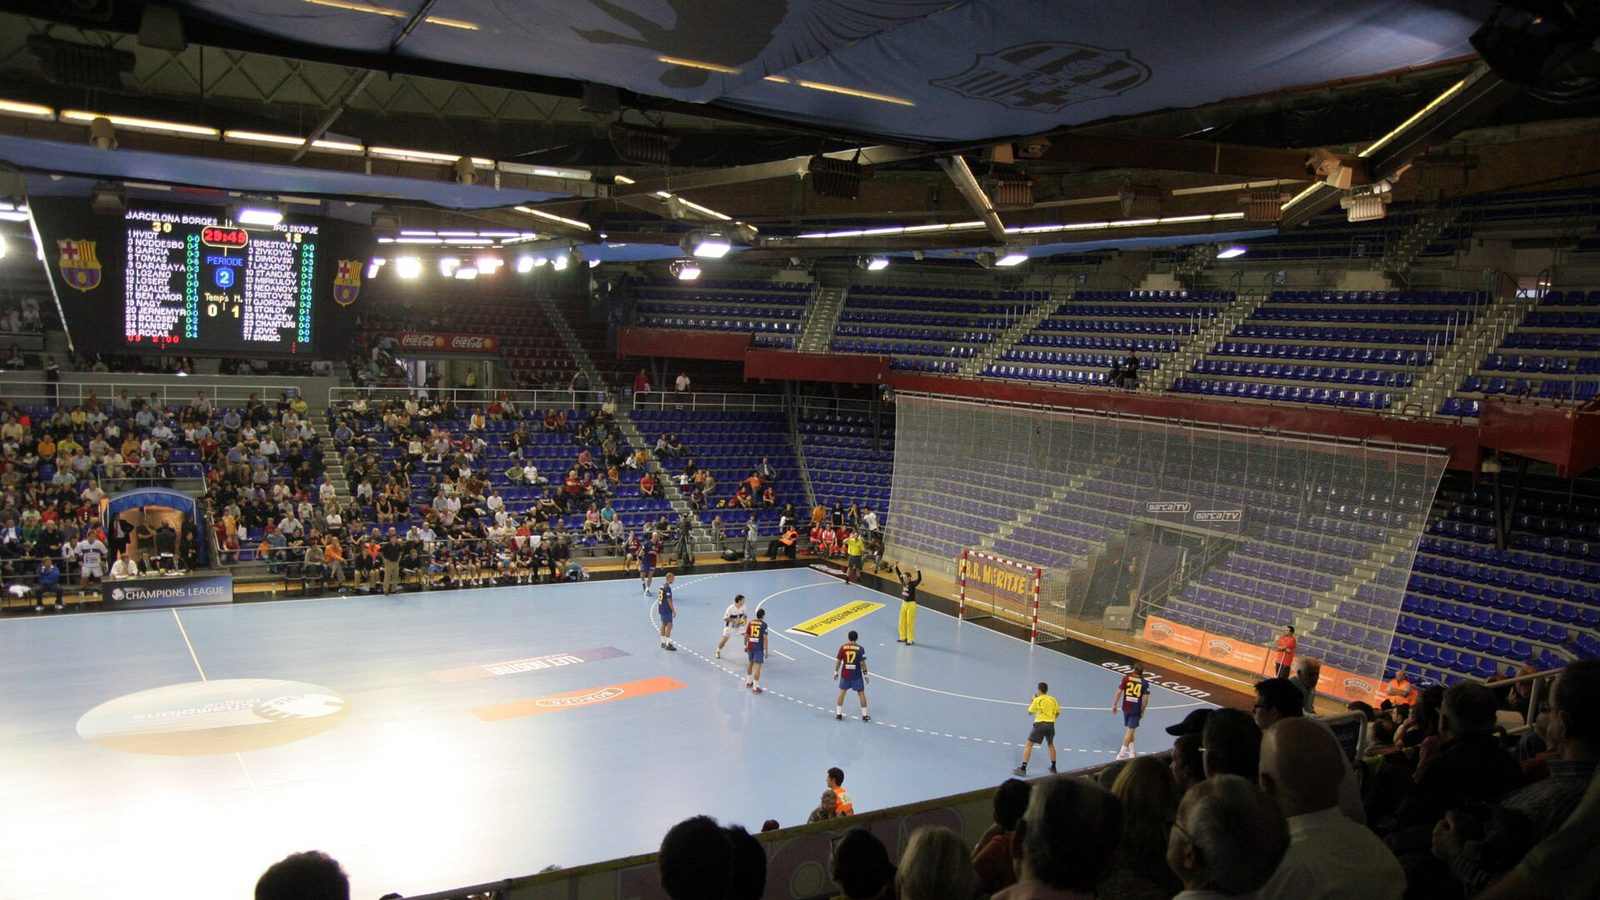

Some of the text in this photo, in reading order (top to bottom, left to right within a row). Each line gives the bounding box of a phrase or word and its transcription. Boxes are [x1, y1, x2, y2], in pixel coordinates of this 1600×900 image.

[152, 222, 172, 232] 30
[290, 226, 318, 234] SKOPJE
[133, 230, 159, 240] HVIDT
[134, 254, 168, 263] TOMAS
[207, 256, 243, 266] PERIODE
[136, 269, 172, 278] LOZANO
[220, 272, 229, 284] 2
[208, 304, 218, 317] 0
[231, 306, 239, 318] 1
[126, 588, 185, 600] CHAMPIONS
[188, 586, 225, 597] LEAGUE
[750, 626, 760, 637] 15
[846, 651, 856, 663] 17
[1126, 682, 1142, 698] 24
